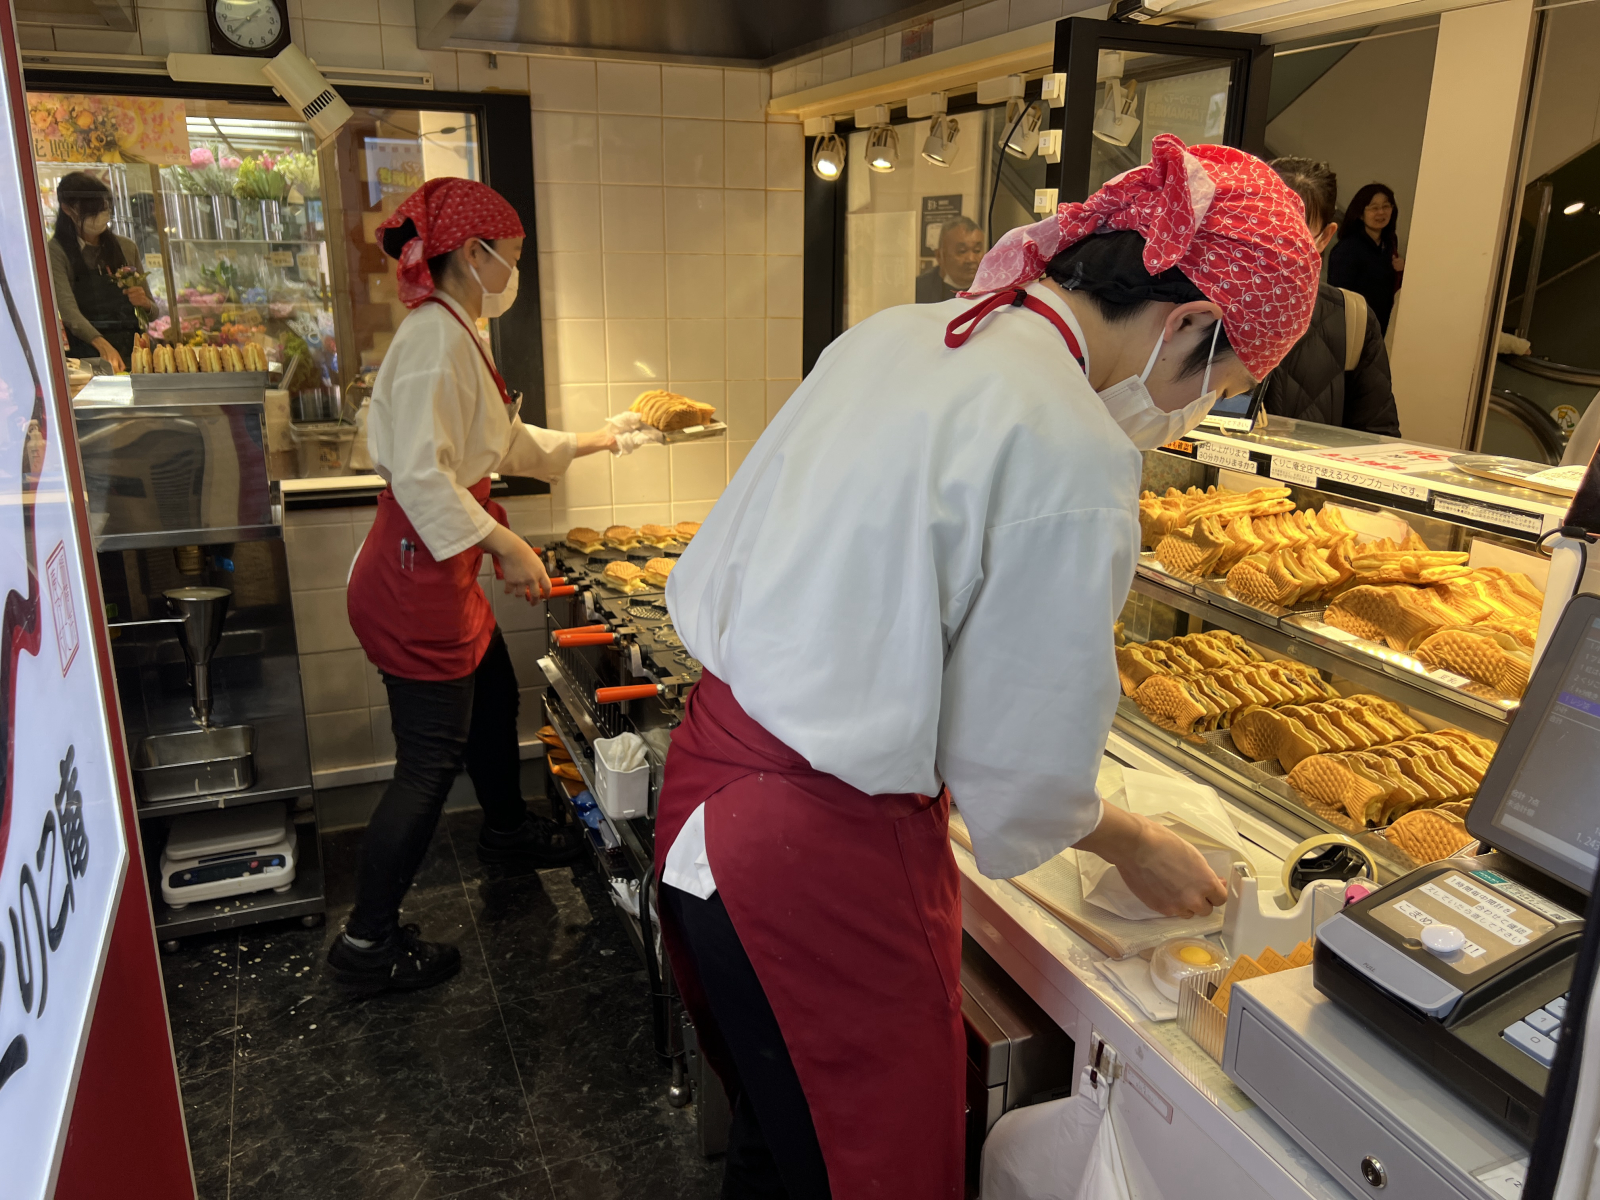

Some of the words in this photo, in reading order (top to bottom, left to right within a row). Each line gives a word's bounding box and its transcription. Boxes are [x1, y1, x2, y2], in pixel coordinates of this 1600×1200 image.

[265, 6, 271, 14] 2
[221, 13, 228, 21] 9
[269, 17, 275, 25] 3
[226, 25, 233, 33] 8
[267, 28, 274, 36] 4
[235, 34, 242, 42] 7
[248, 37, 255, 46] 6
[260, 36, 266, 44] 5
[1199, 440, 1248, 459] お召し上がりまで
[1272, 456, 1421, 498] くりこ庵全店で使えるスタンプカードです。
[1270, 959, 1280, 970] 10
[1362, 961, 1376, 973] PULL
[1530, 1036, 1541, 1044] 0
